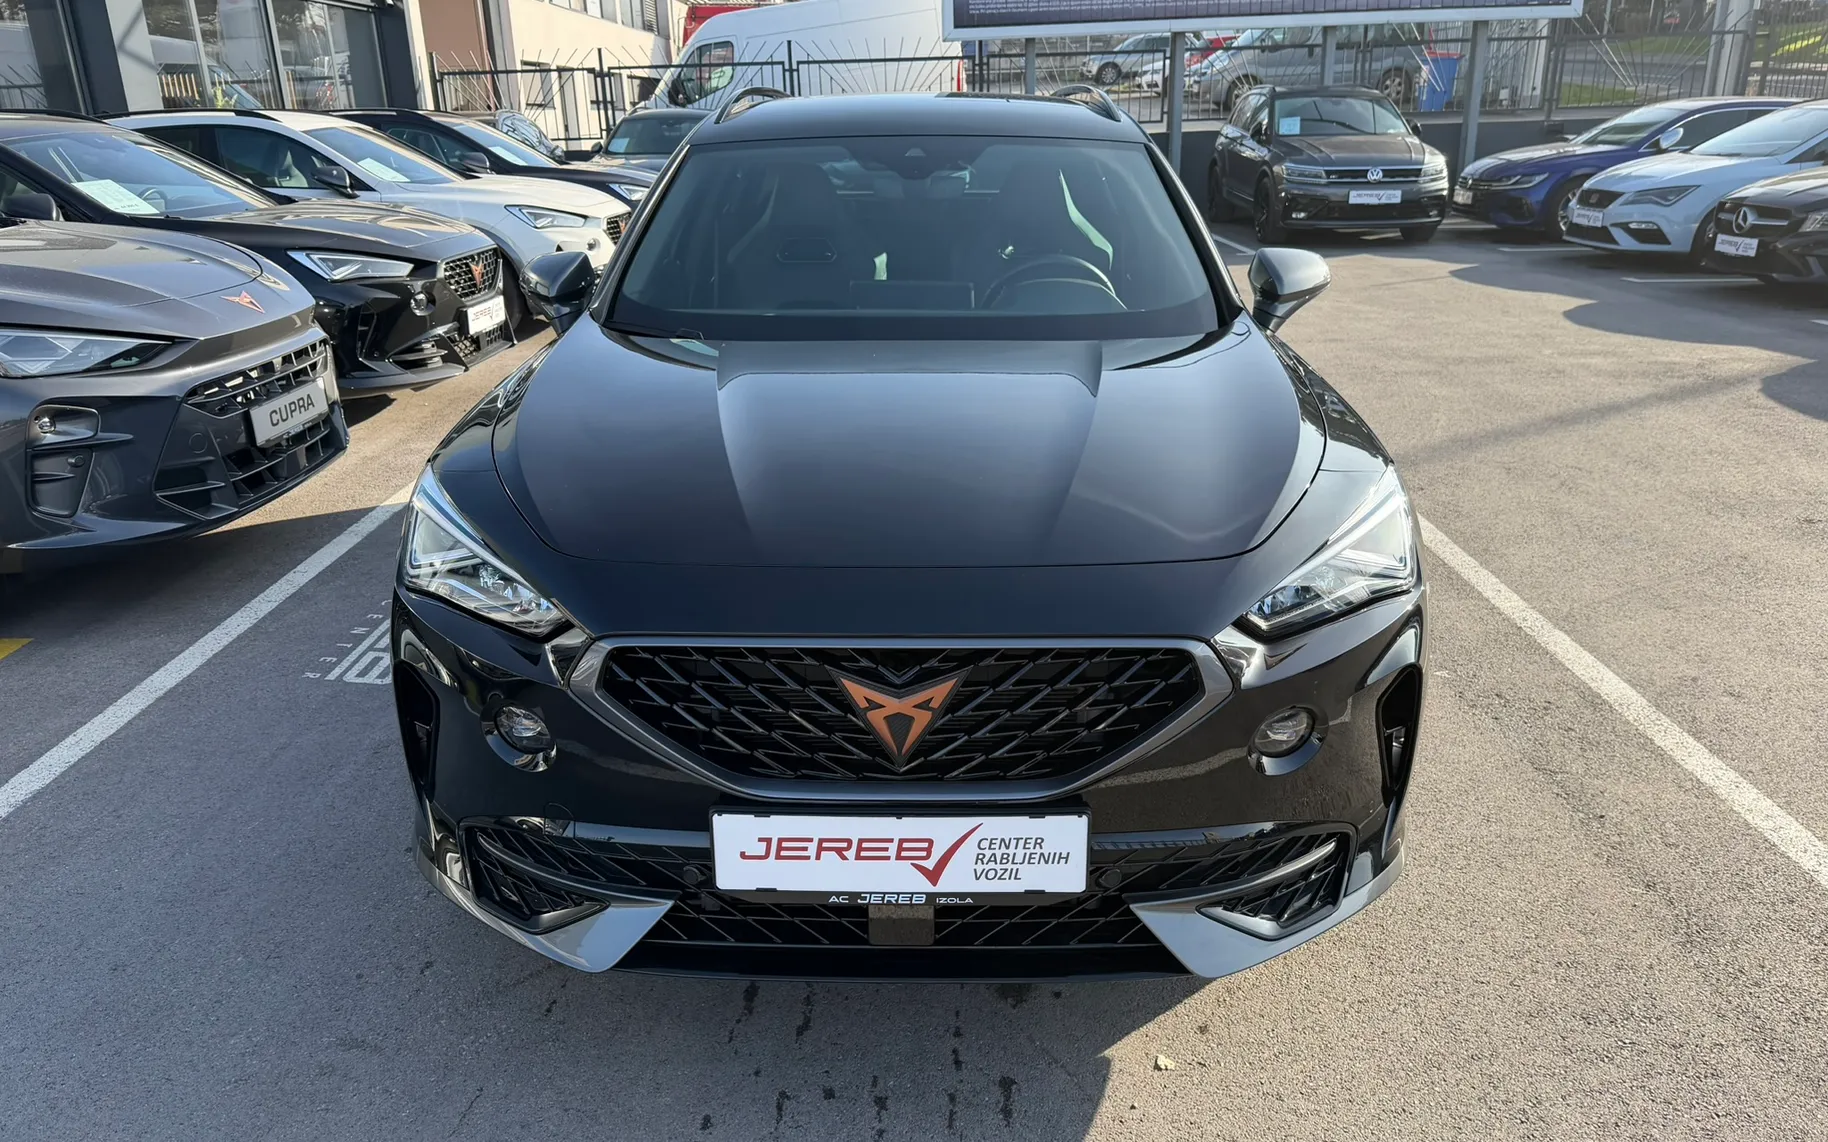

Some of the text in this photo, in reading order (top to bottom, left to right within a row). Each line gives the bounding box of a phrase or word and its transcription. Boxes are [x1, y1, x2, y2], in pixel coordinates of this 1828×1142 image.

[269, 393, 315, 427] CUPRA
[739, 836, 934, 862] JEREB
[977, 836, 1045, 851] CENTER
[974, 851, 1071, 866] RABLJENIH
[973, 867, 1022, 881] VOZIL
[828, 893, 974, 904] AC JEREB IZOLA
